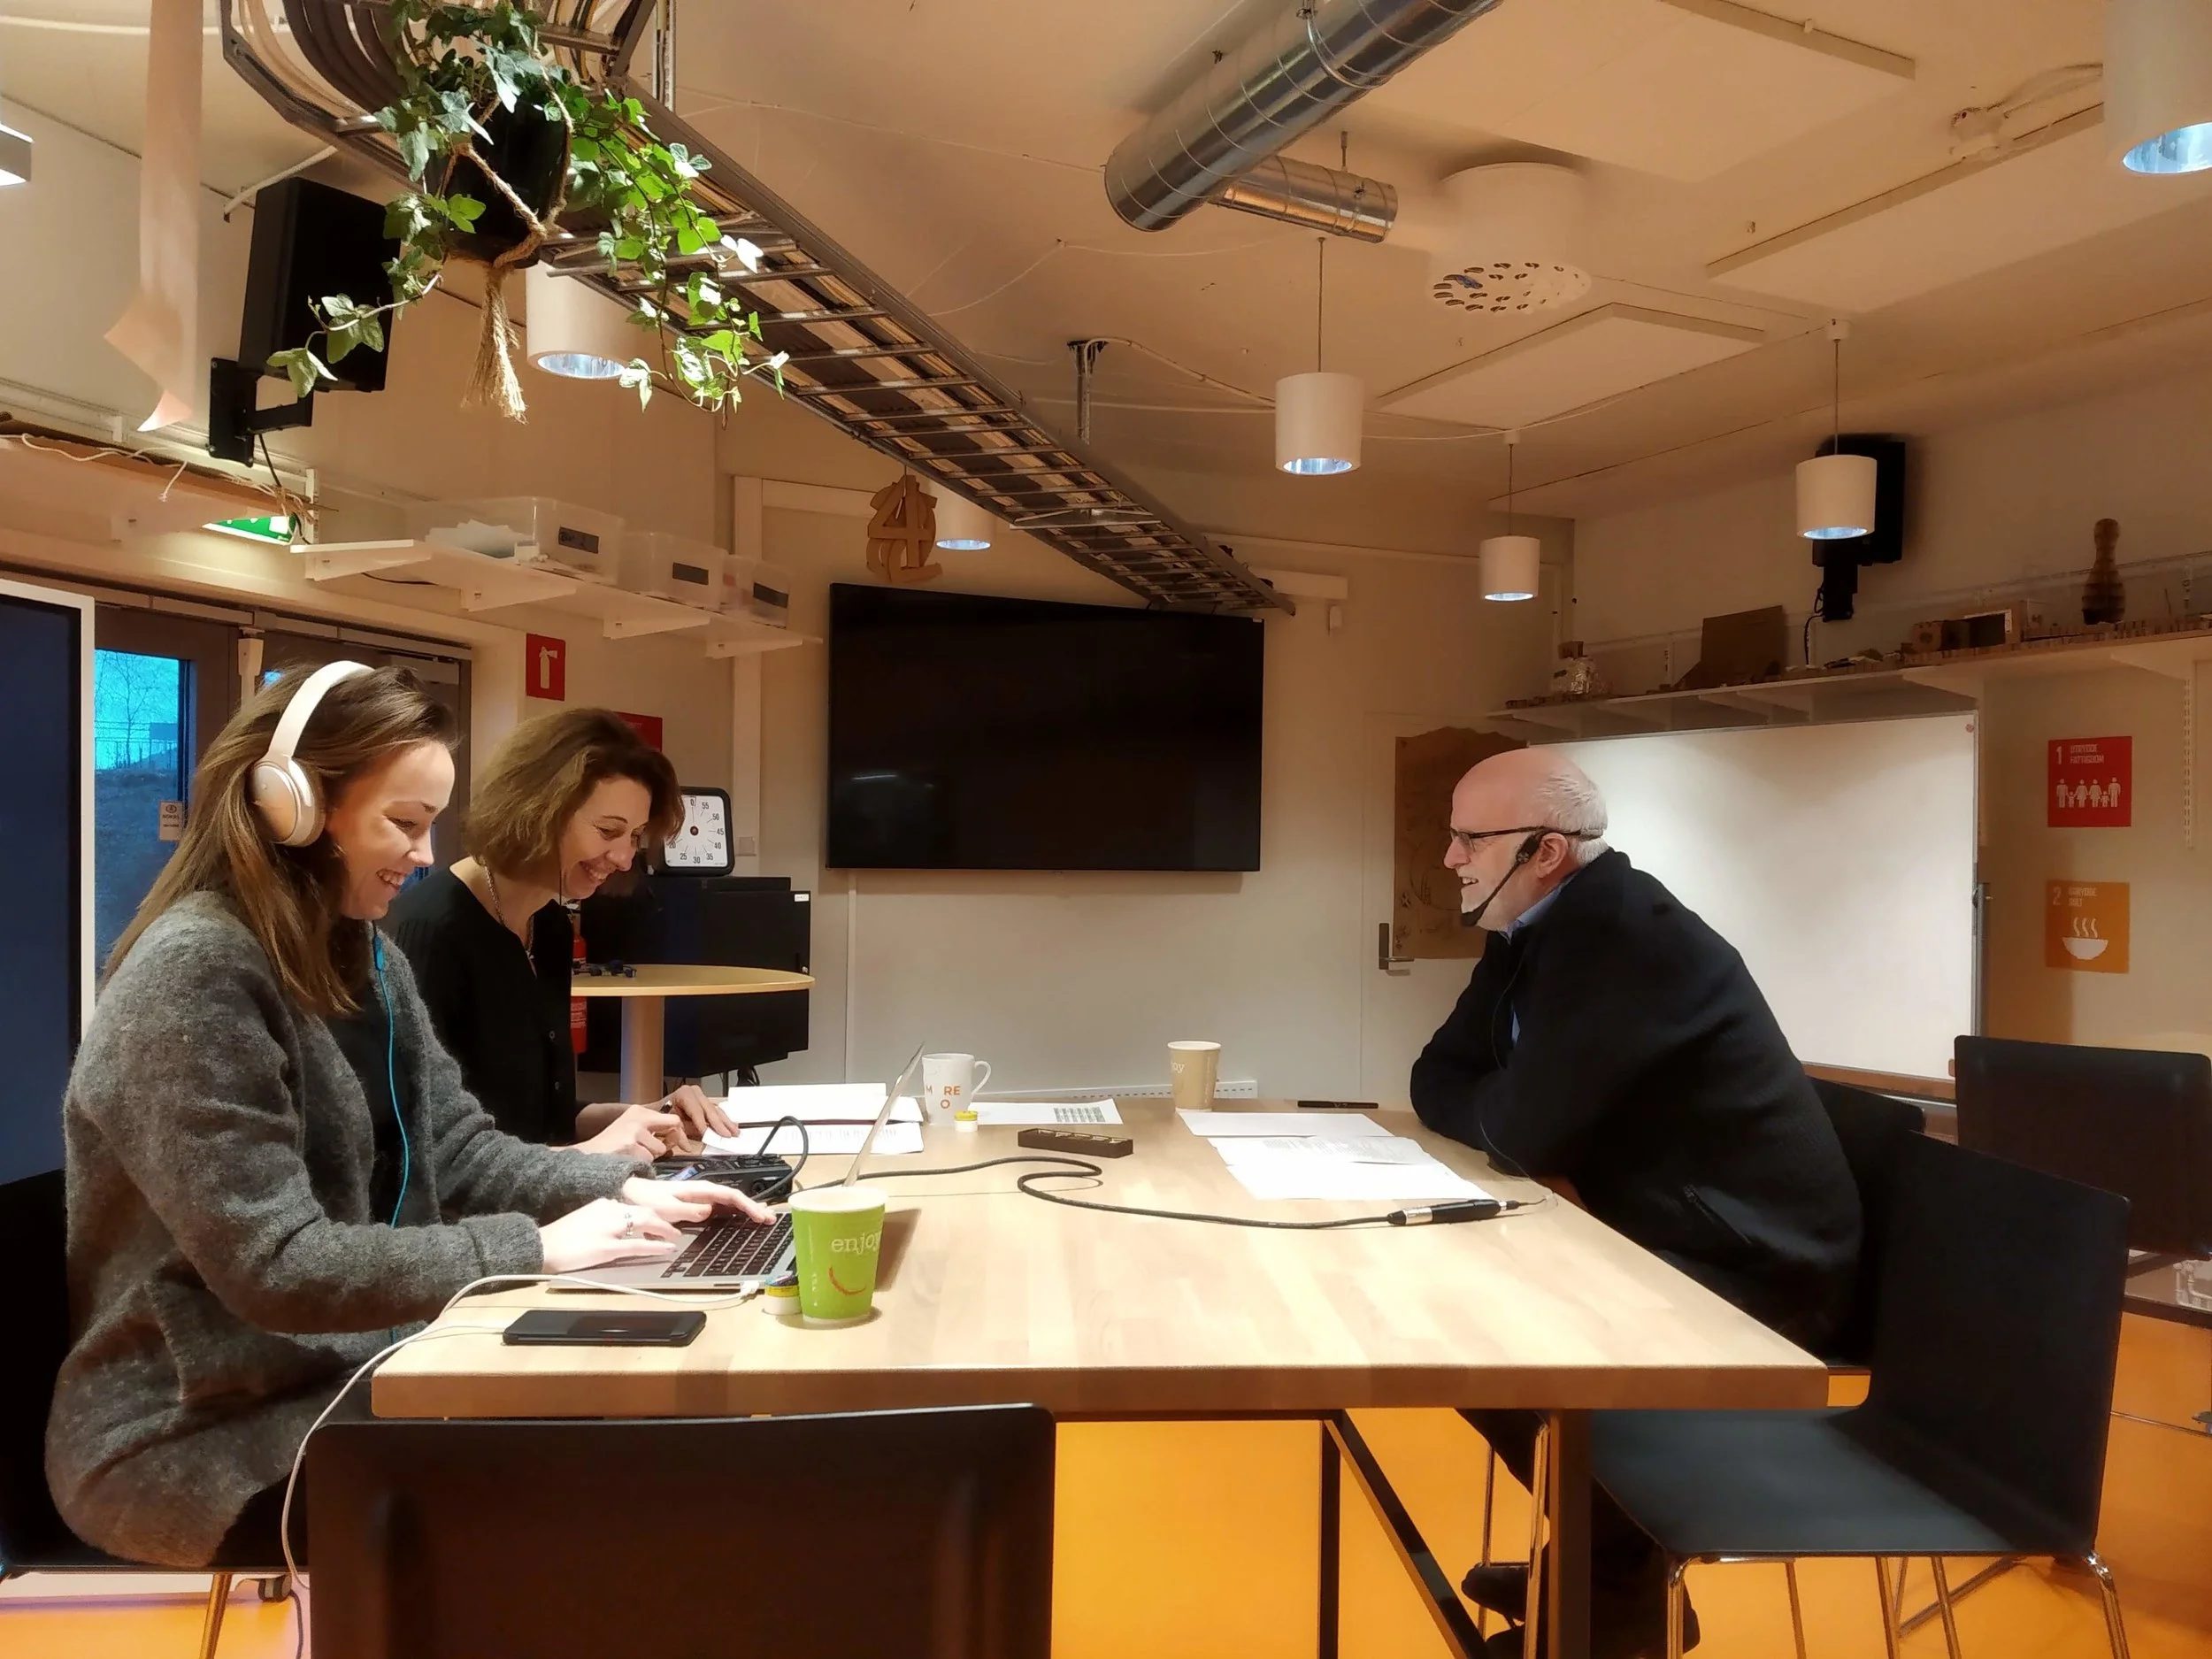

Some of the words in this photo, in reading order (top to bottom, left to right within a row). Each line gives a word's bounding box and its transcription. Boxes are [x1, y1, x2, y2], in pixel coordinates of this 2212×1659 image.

[2056, 746, 2062, 765] 1
[2053, 886, 2062, 905] 2
[943, 1085, 961, 1095] RE
[940, 1099, 950, 1109] O
